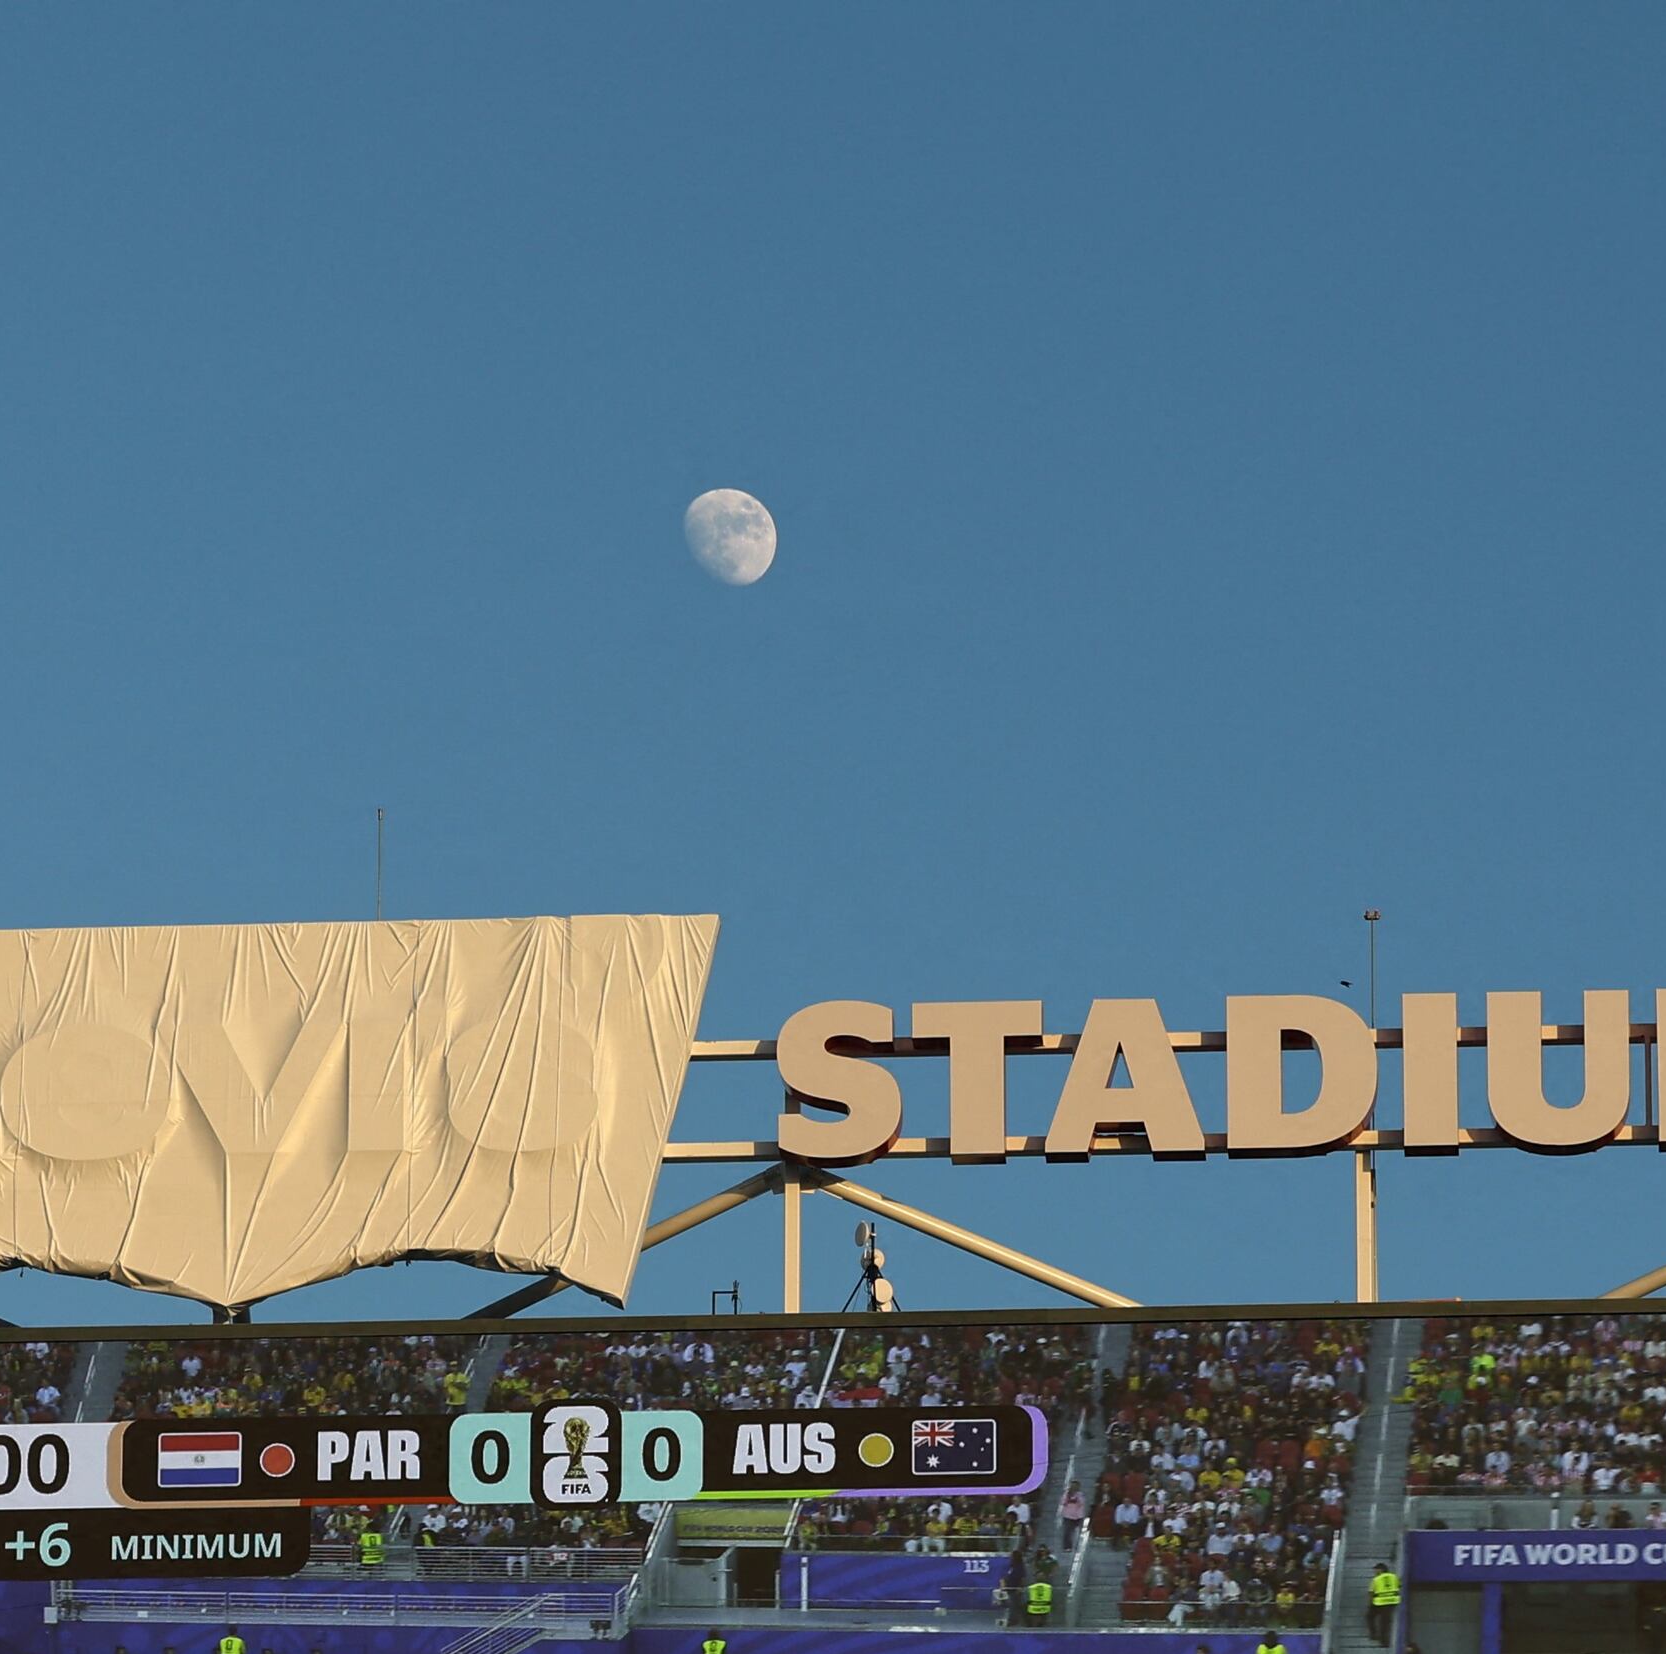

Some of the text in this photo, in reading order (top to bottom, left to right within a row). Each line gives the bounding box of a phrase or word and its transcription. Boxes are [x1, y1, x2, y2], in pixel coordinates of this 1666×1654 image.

[317, 1430, 510, 1485] PAR 0
[642, 1422, 836, 1482] 0 AUS
[561, 1484, 592, 1495] FIFA
[4, 1523, 71, 1567] +6
[111, 1533, 282, 1561] MINIMUM
[1454, 1544, 1520, 1566] FIFA
[1524, 1543, 1638, 1565] WORLD
[963, 1559, 990, 1573] 113
